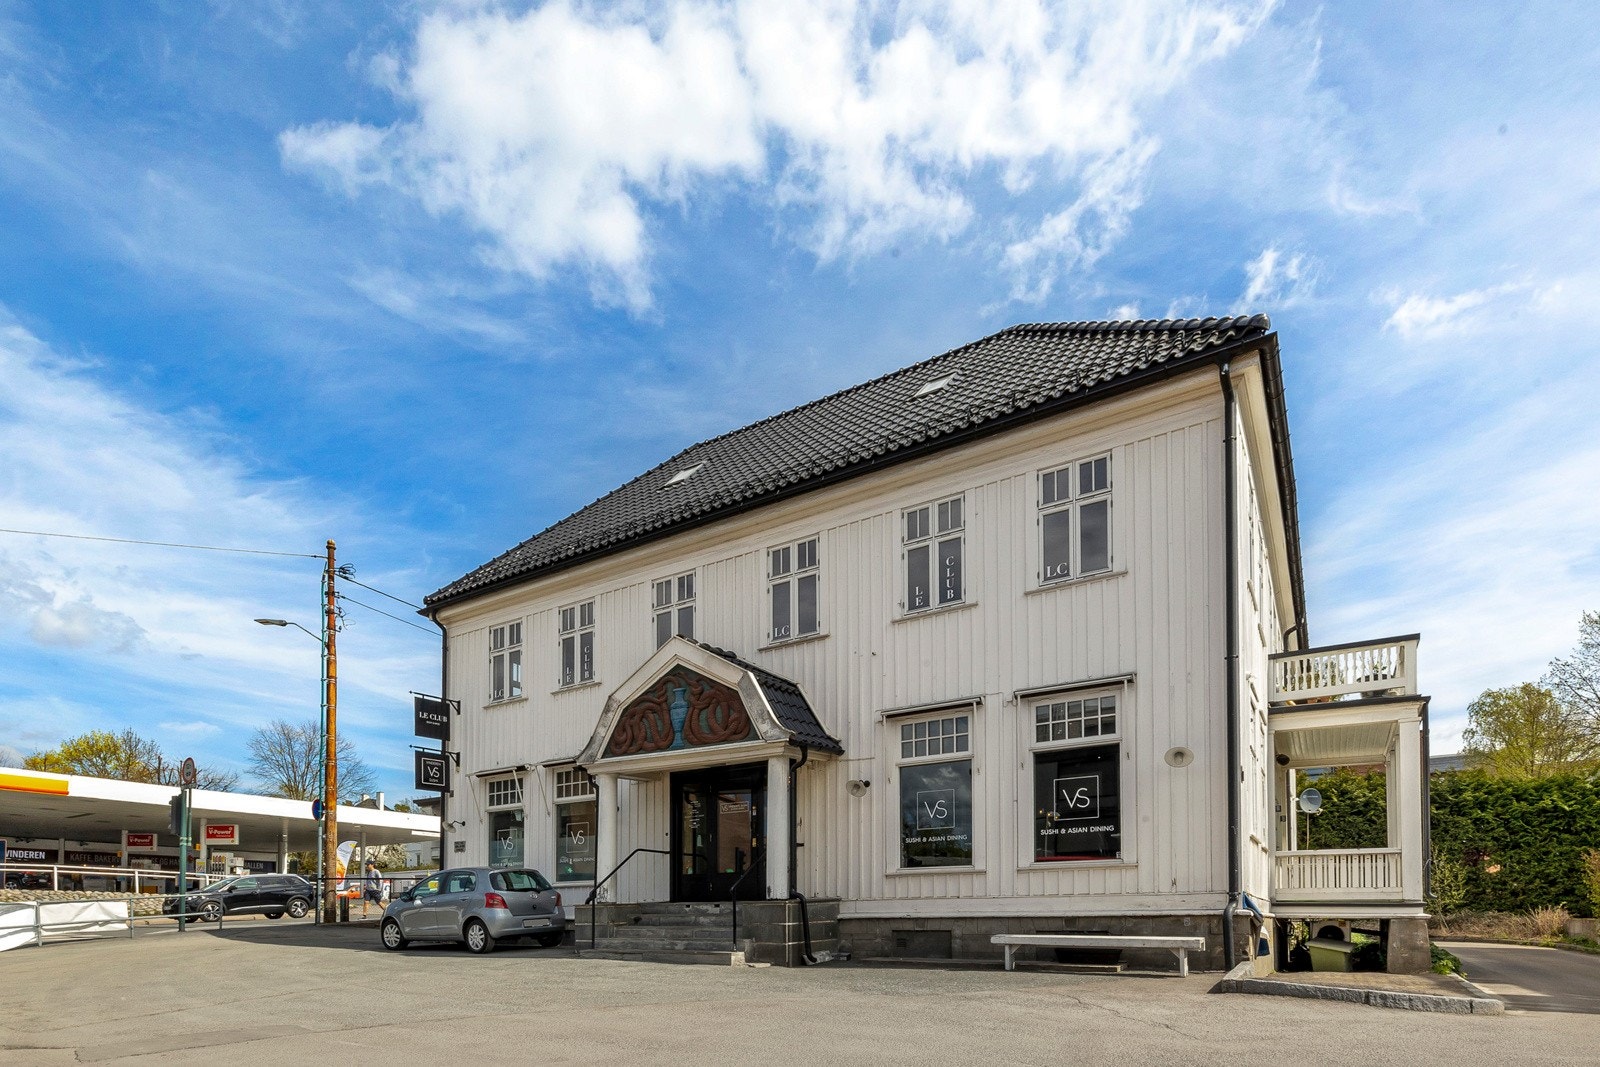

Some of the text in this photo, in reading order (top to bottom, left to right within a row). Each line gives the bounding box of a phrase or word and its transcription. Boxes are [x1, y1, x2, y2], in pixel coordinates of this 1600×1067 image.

[1047, 562, 1067, 578] LC
[915, 556, 954, 606] LE CLUB
[774, 625, 790, 637] LC
[419, 711, 448, 722] LE CLUB
[427, 766, 440, 778] VS
[1062, 787, 1090, 808] VS
[924, 800, 948, 818] VS
[501, 837, 514, 850] VS
[571, 830, 585, 844] VS
